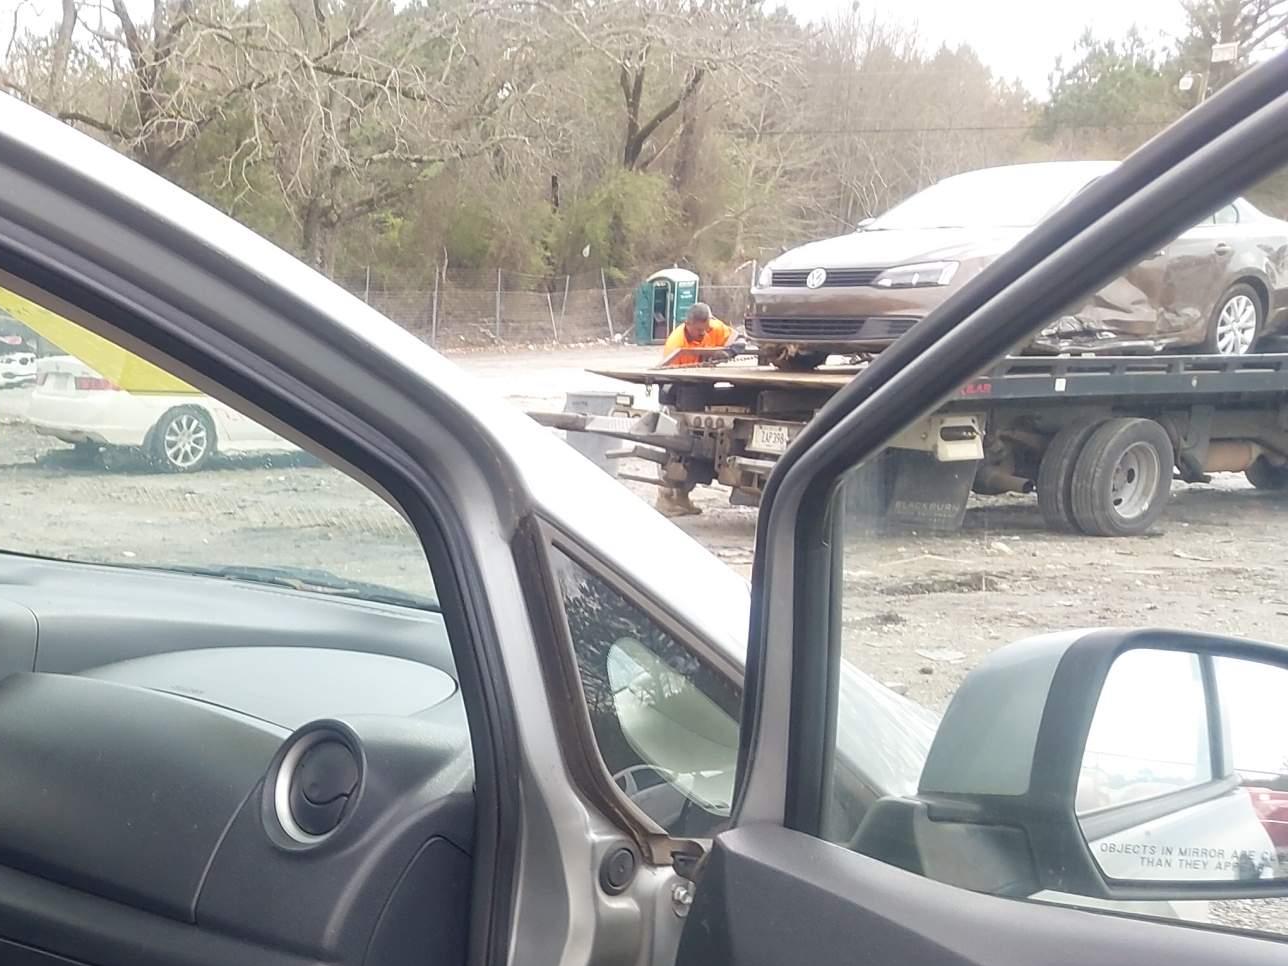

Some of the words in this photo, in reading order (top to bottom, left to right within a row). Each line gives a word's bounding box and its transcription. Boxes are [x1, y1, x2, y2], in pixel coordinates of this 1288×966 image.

[895, 501, 961, 512] BLACKBURN
[1100, 842, 1156, 856] OBJECTS
[1161, 845, 1173, 856] IN
[1177, 847, 1225, 859] MIRROR
[1140, 856, 1172, 868] THAN
[1178, 858, 1208, 870] THEY
